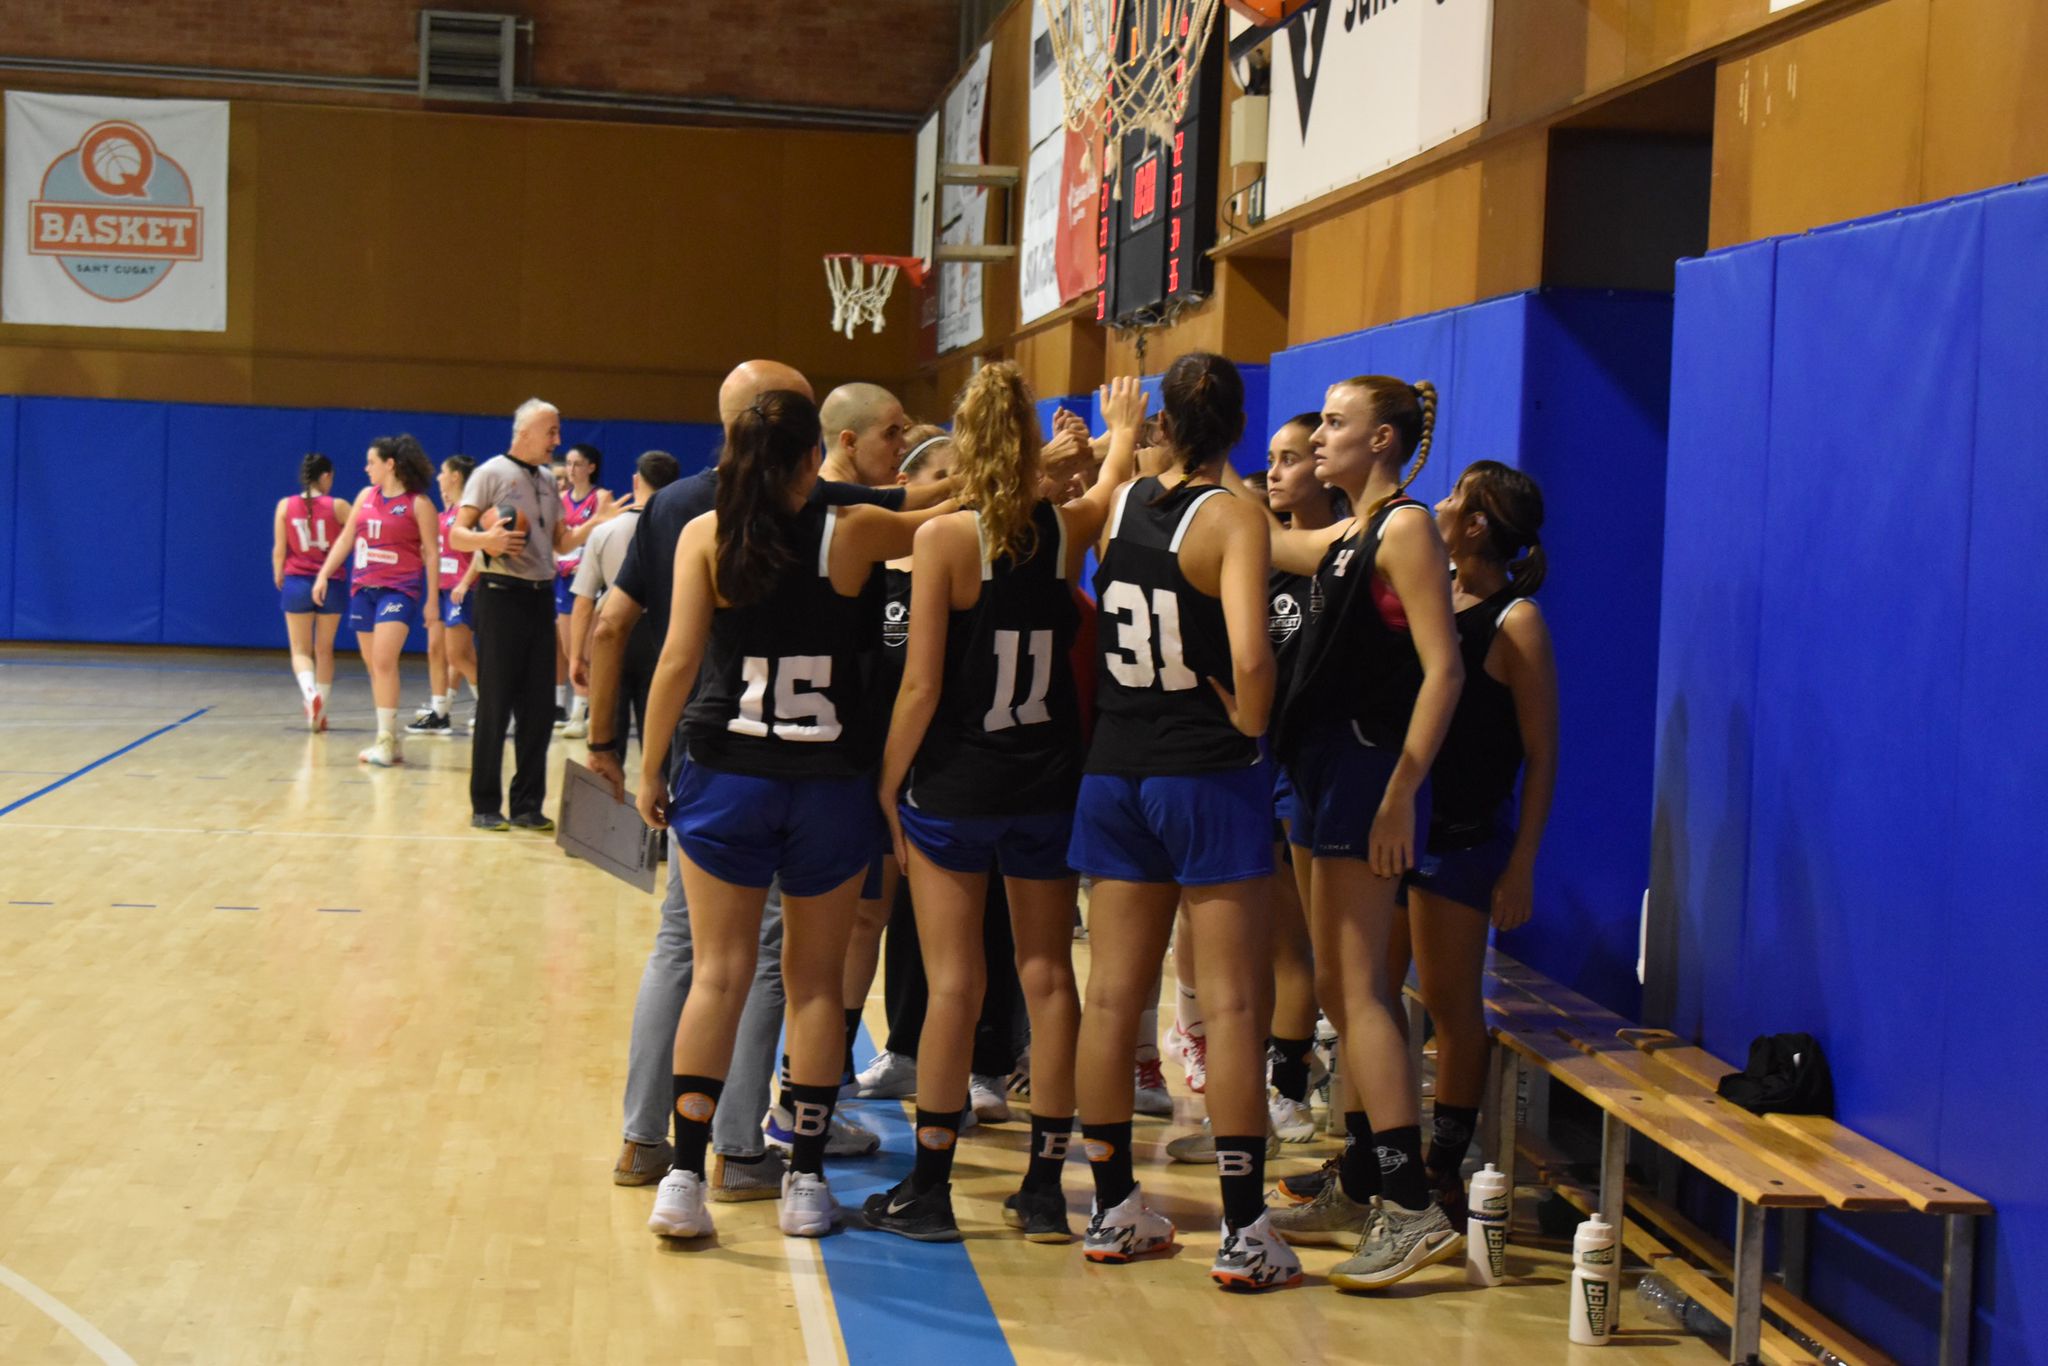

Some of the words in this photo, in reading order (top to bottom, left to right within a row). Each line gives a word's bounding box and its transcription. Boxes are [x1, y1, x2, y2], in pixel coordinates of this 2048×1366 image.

[39, 212, 193, 248] BASKET
[76, 264, 109, 274] SANT
[114, 265, 156, 275] CUGAT
[291, 518, 330, 553] 14
[367, 518, 382, 540] 11
[1101, 581, 1198, 692] 31
[726, 654, 843, 742] 15
[982, 629, 1054, 733] 11
[793, 1100, 829, 1137] B
[1215, 1150, 1254, 1177] B
[1487, 1229, 1504, 1277] FINISHER
[1586, 1284, 1606, 1336] FINISHER
